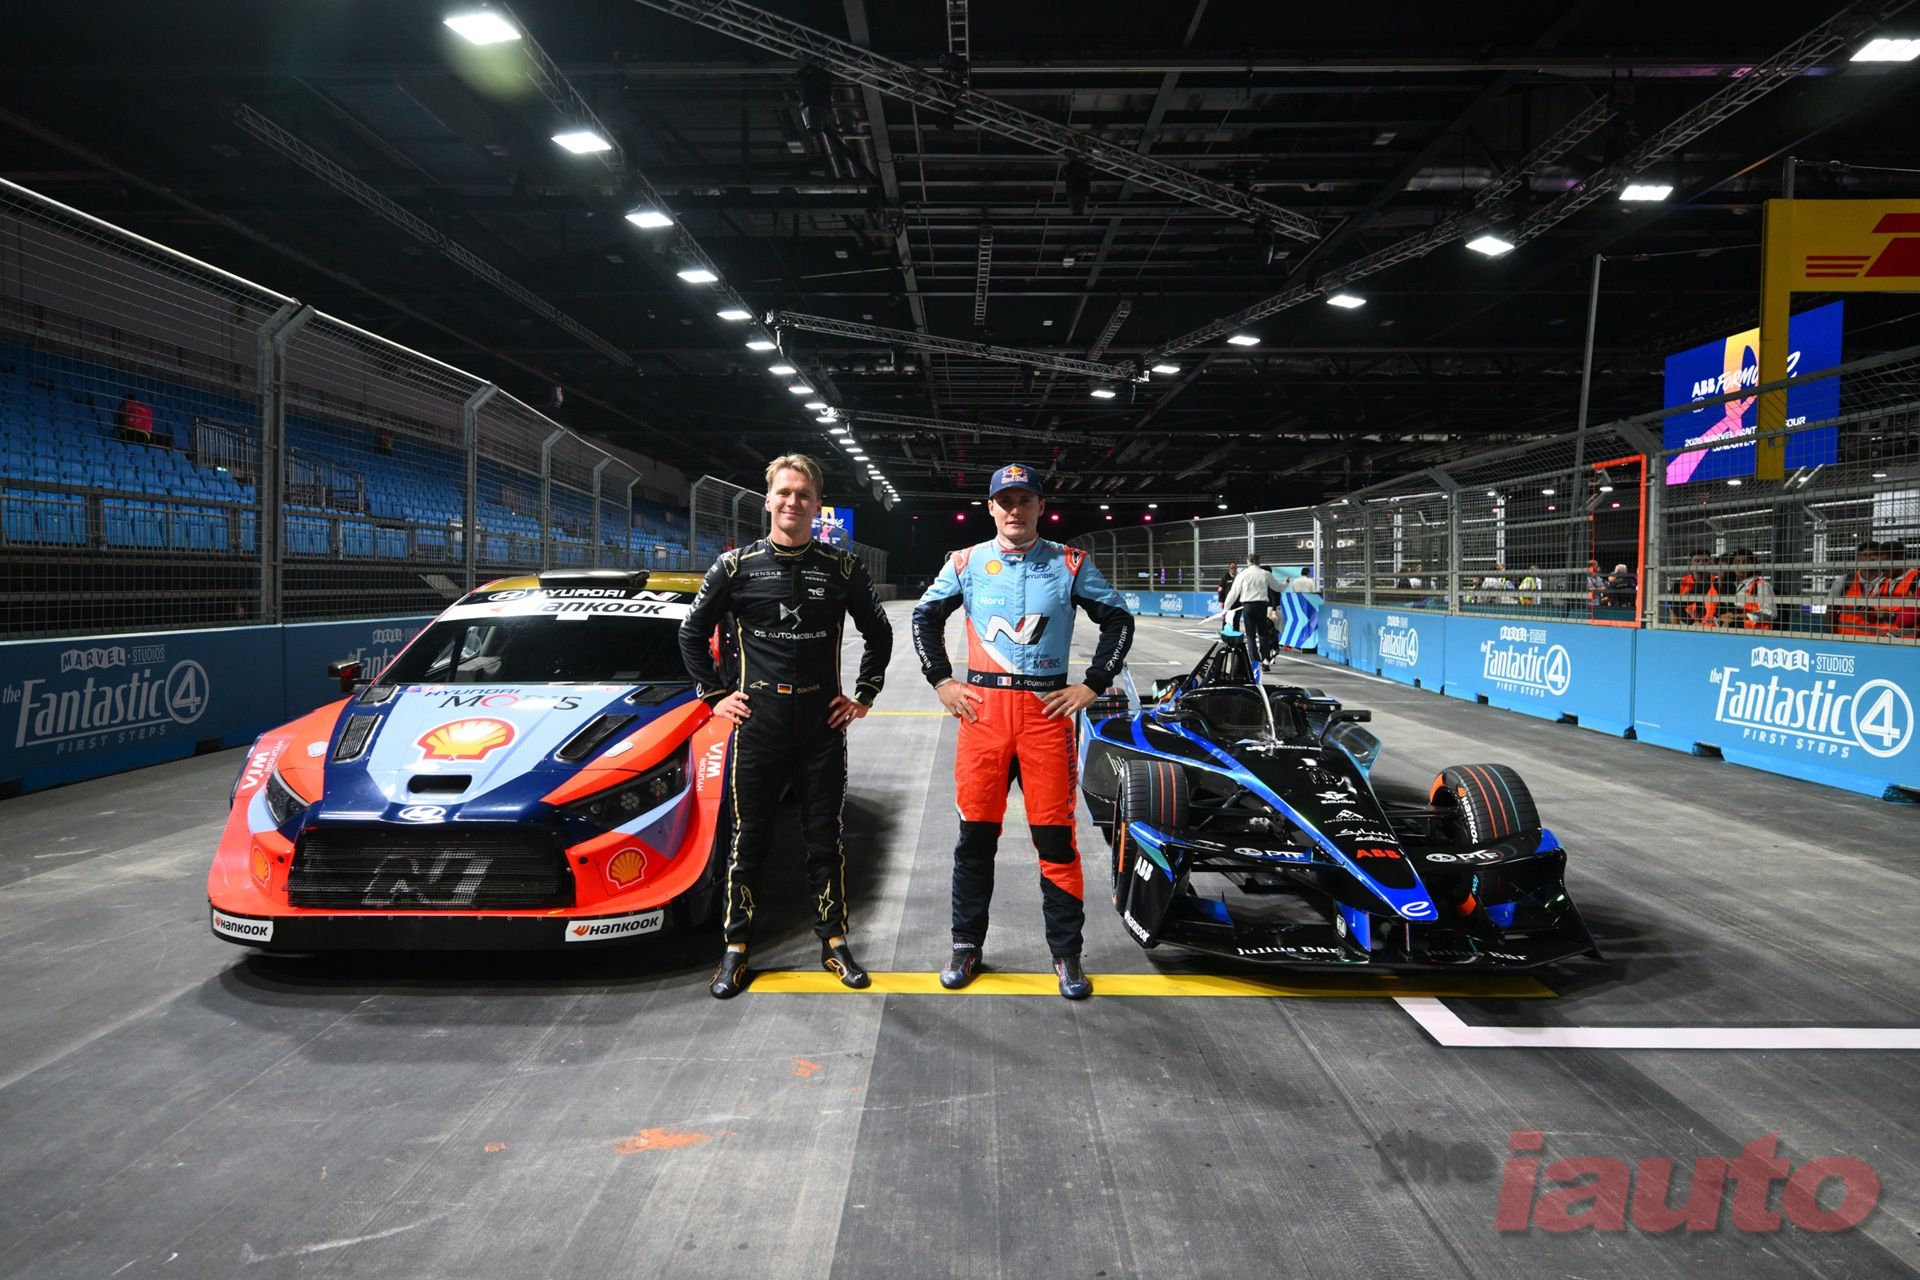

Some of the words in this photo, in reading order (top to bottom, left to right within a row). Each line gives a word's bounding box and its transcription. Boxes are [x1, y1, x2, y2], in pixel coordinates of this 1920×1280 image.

[1692, 378, 1715, 398] ABB
[532, 589, 626, 598] HYUNDAI
[980, 596, 1005, 606] Nord
[539, 600, 666, 615] ankook
[767, 630, 827, 640] AUTOMOBILES
[1111, 625, 1128, 661] HYUNDAI
[62, 647, 125, 672] MARVEL
[132, 647, 165, 664] STUDIOS
[1483, 640, 1546, 683] Fantastic
[1751, 646, 1809, 672] MARVEL
[1815, 653, 1855, 675] STUDIOS
[1709, 668, 1723, 684] the
[425, 688, 521, 697] HYUNDAI
[1715, 667, 1852, 736] Fantastic
[15, 669, 166, 748] Fantastic
[169, 663, 204, 719] 4
[1856, 685, 1906, 752] 4
[57, 735, 108, 754] FIRST
[118, 724, 166, 744] STEPS
[1743, 728, 1788, 746] FIRST
[1795, 738, 1850, 759] STEPS
[1357, 847, 1401, 859] ABB
[1134, 855, 1154, 882] ABB
[1237, 947, 1297, 956] Julius
